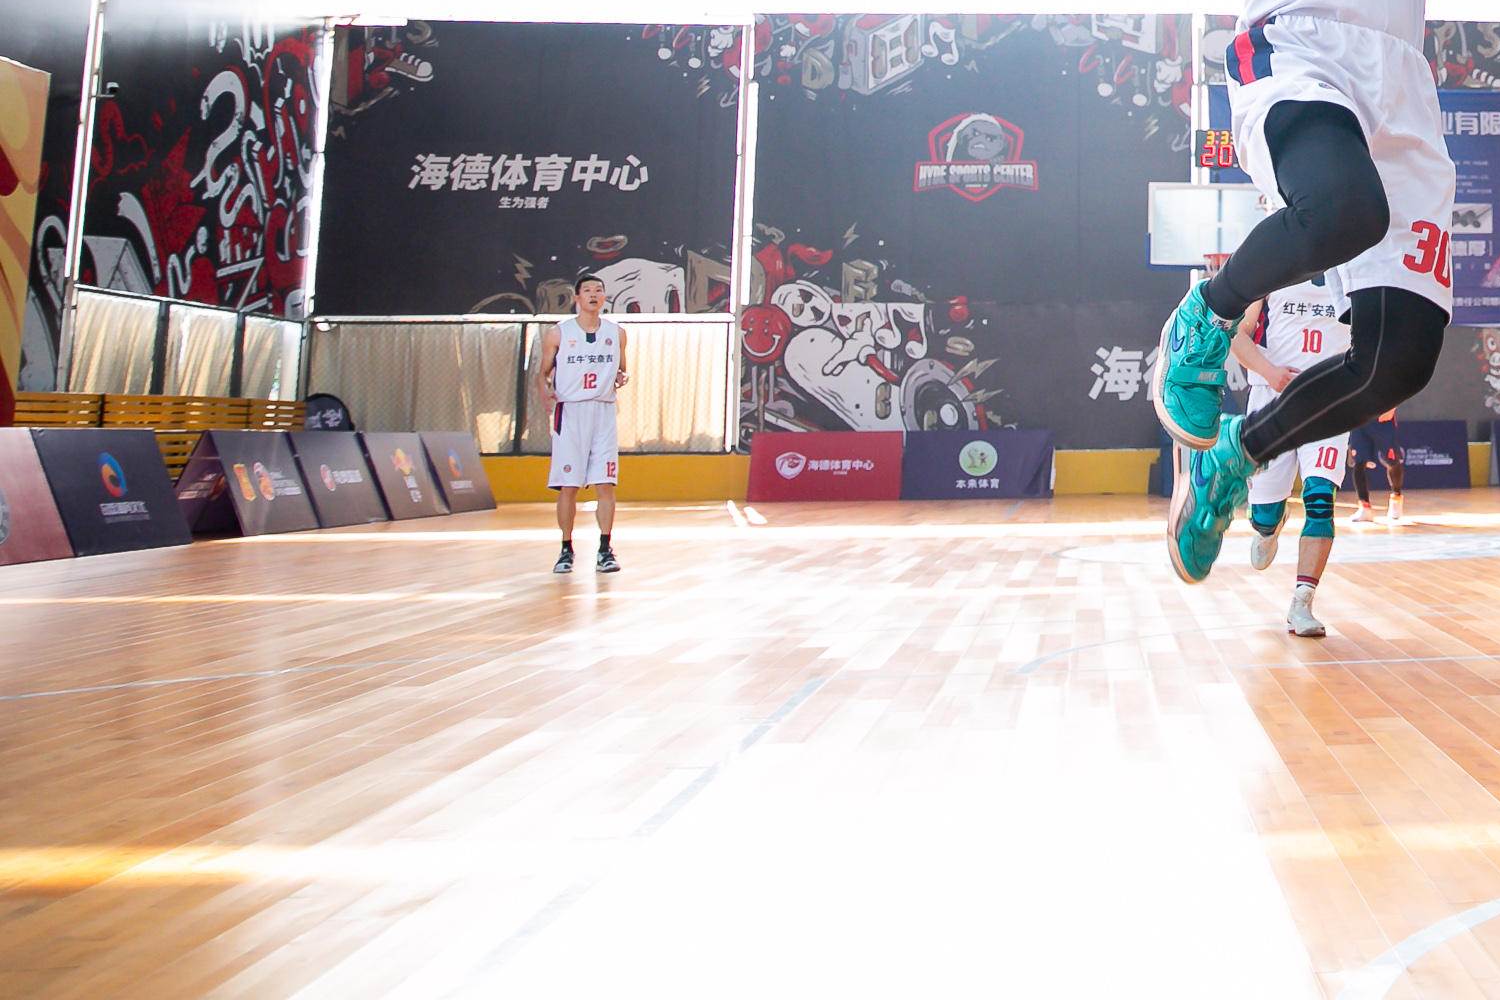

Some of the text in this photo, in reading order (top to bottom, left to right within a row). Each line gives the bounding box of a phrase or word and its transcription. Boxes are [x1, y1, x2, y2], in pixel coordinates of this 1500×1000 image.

[408, 153, 649, 192] 海德体育中心
[919, 164, 1035, 187] HYDE SPORTS CENTER
[498, 197, 549, 209] 生为强者
[1302, 328, 1323, 354] 10
[583, 373, 598, 389] 12
[1197, 371, 1219, 382] NIKE
[1315, 446, 1339, 470] 10
[606, 461, 616, 478] 12
